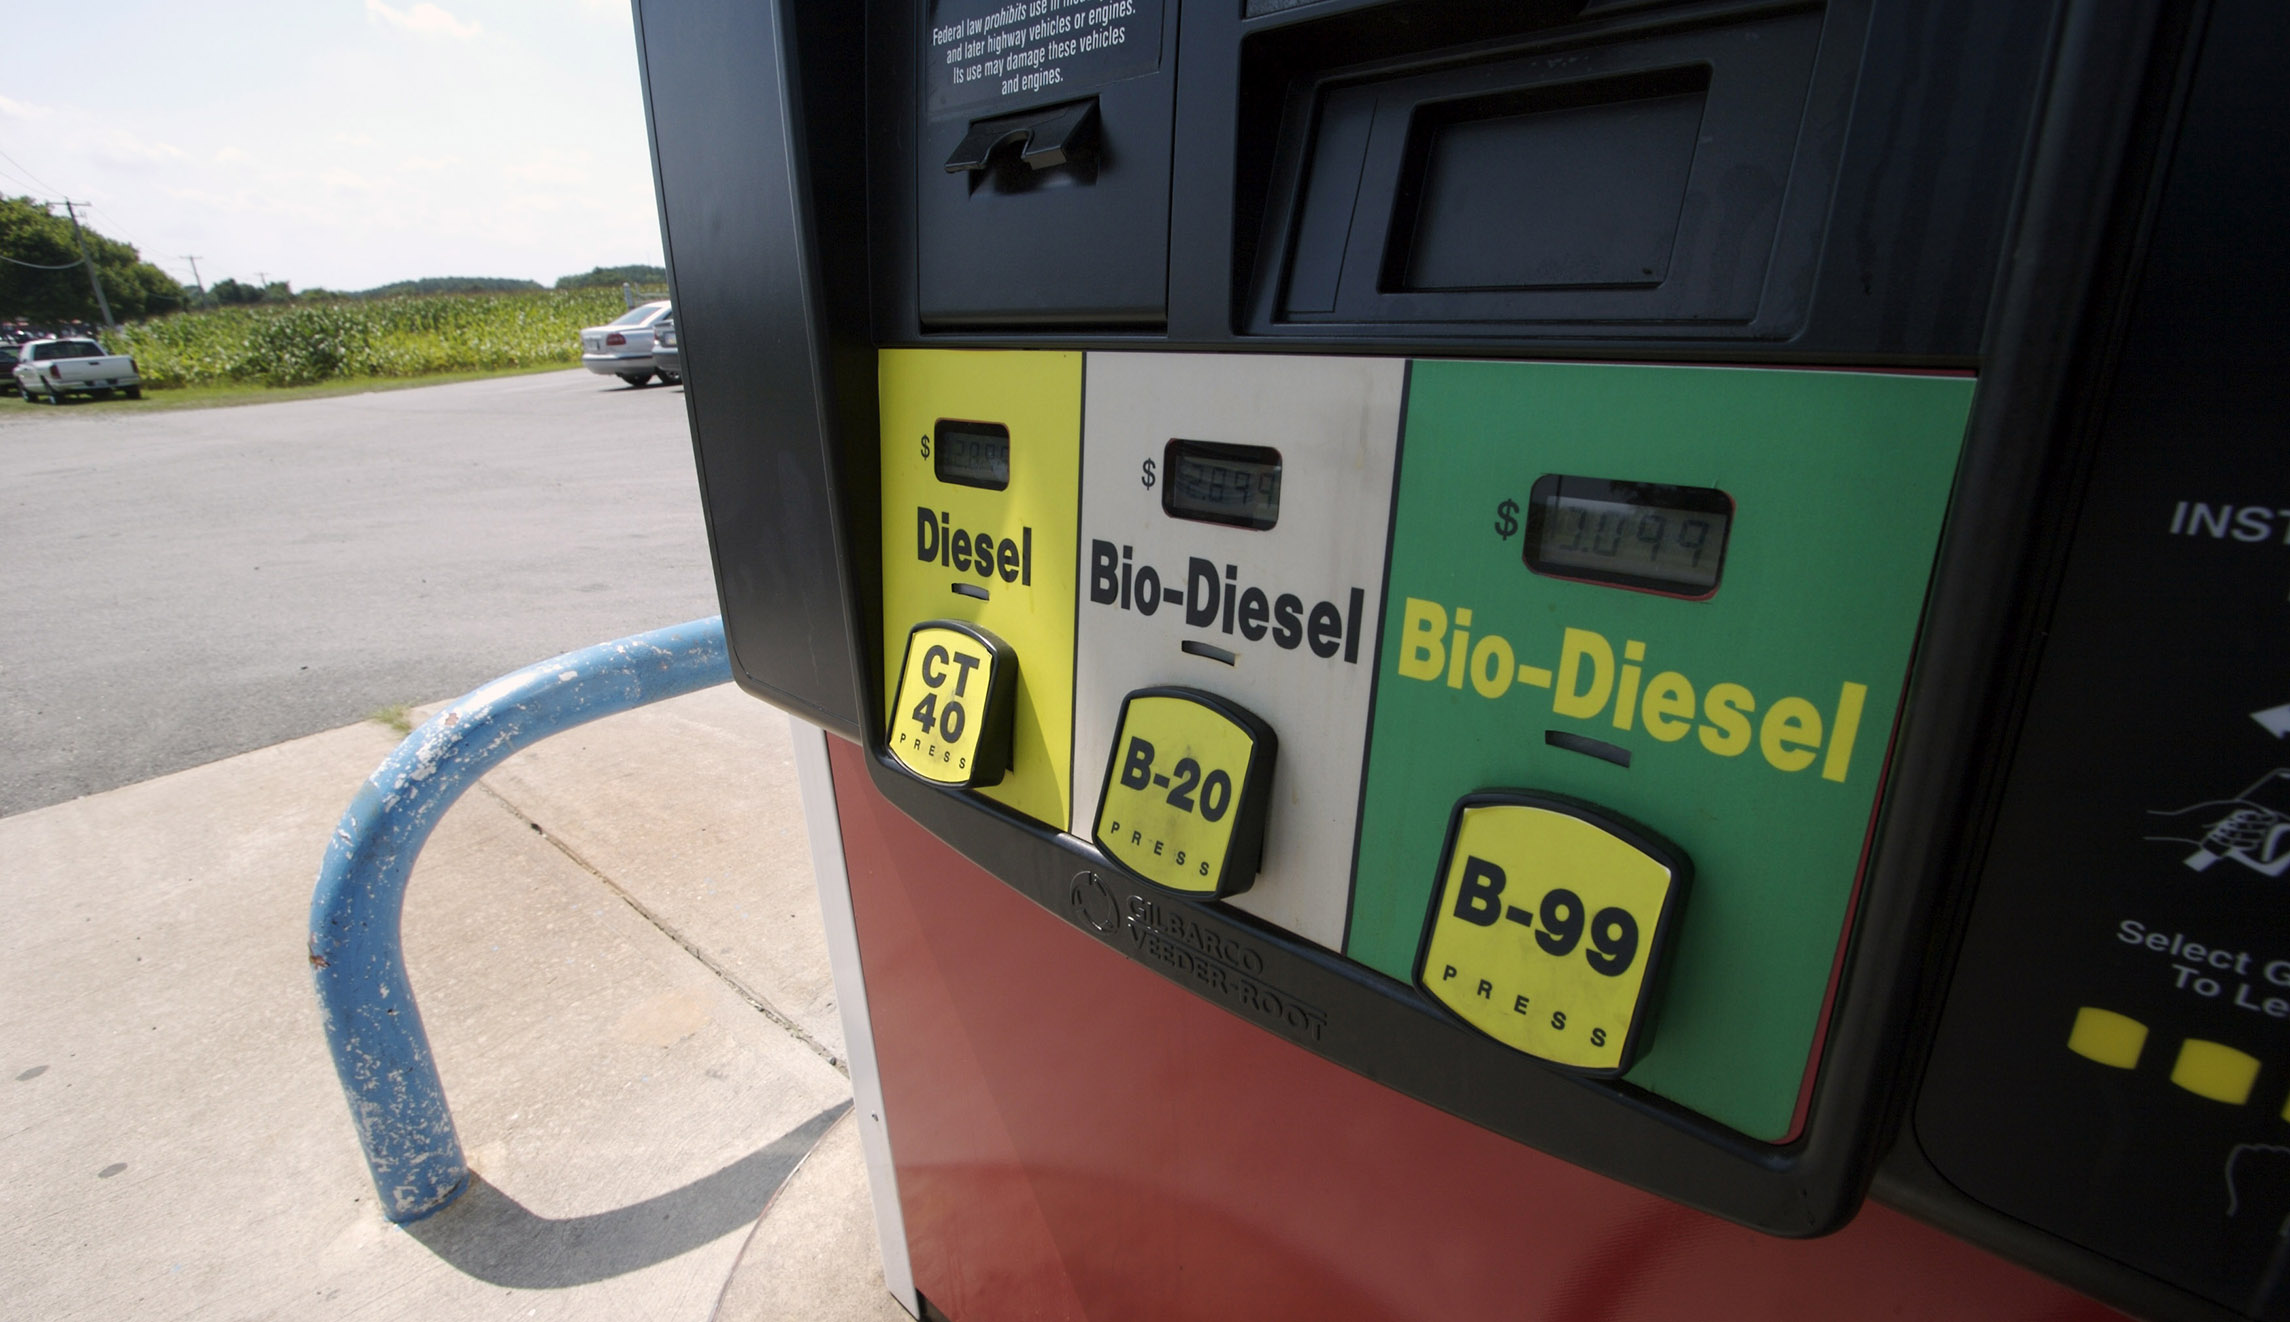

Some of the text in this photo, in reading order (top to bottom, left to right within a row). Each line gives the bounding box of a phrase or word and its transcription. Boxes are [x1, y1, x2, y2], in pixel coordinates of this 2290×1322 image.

[932, 20, 965, 46] Federal
[967, 18, 983, 37] law
[983, 4, 1027, 36] prohibits
[1029, 0, 1047, 17] use
[946, 0, 1136, 64] and later highway vehicles or engines.
[953, 26, 1125, 84] Its use may damage these vehicles
[1001, 67, 1063, 95] and engines.
[920, 434, 931, 461] $
[1141, 458, 1156, 490] $
[917, 507, 1032, 586] Diesel
[1494, 499, 1520, 541] $
[1090, 538, 1365, 664] Bio-Diesel
[922, 645, 980, 698] CT
[1398, 597, 1868, 783] Bio-Diesel
[912, 693, 966, 744] 40
[900, 733, 966, 769] PRESS
[1120, 736, 1232, 823] B-20
[1111, 821, 1209, 877] PRESS
[1127, 894, 1264, 976] GILBARCO
[1453, 855, 1639, 977] B-99
[2116, 919, 2252, 976] Select
[1128, 922, 1327, 1042] VEEDER-ROOT
[1443, 965, 1607, 1048] PRESS
[2171, 963, 2222, 998] To
